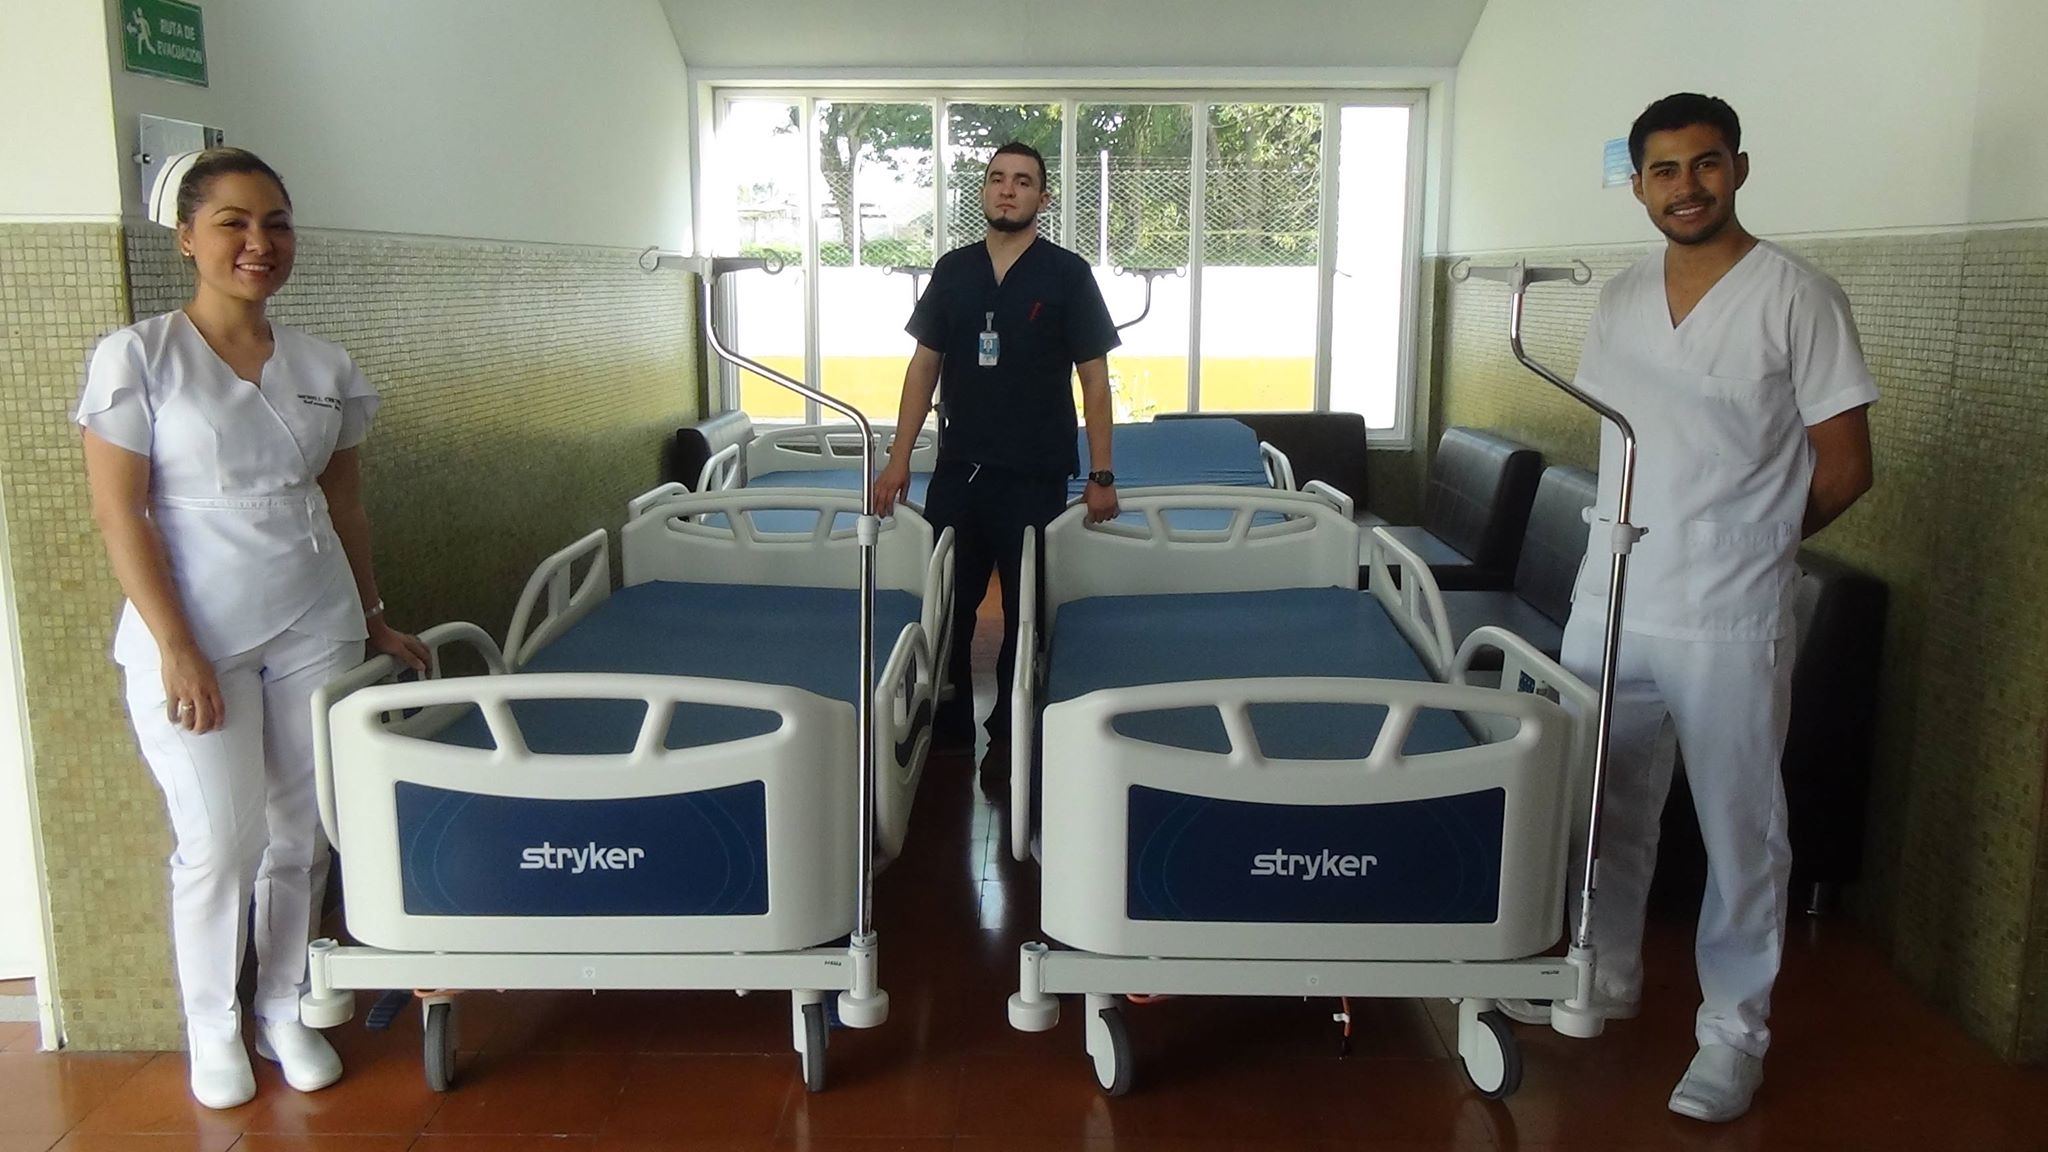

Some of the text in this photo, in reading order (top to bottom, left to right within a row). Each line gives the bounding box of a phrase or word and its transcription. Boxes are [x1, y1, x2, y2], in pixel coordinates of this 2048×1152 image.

[160, 18, 196, 41] RUTA DE
[519, 841, 645, 874] stryker
[1250, 848, 1378, 880] stryker
